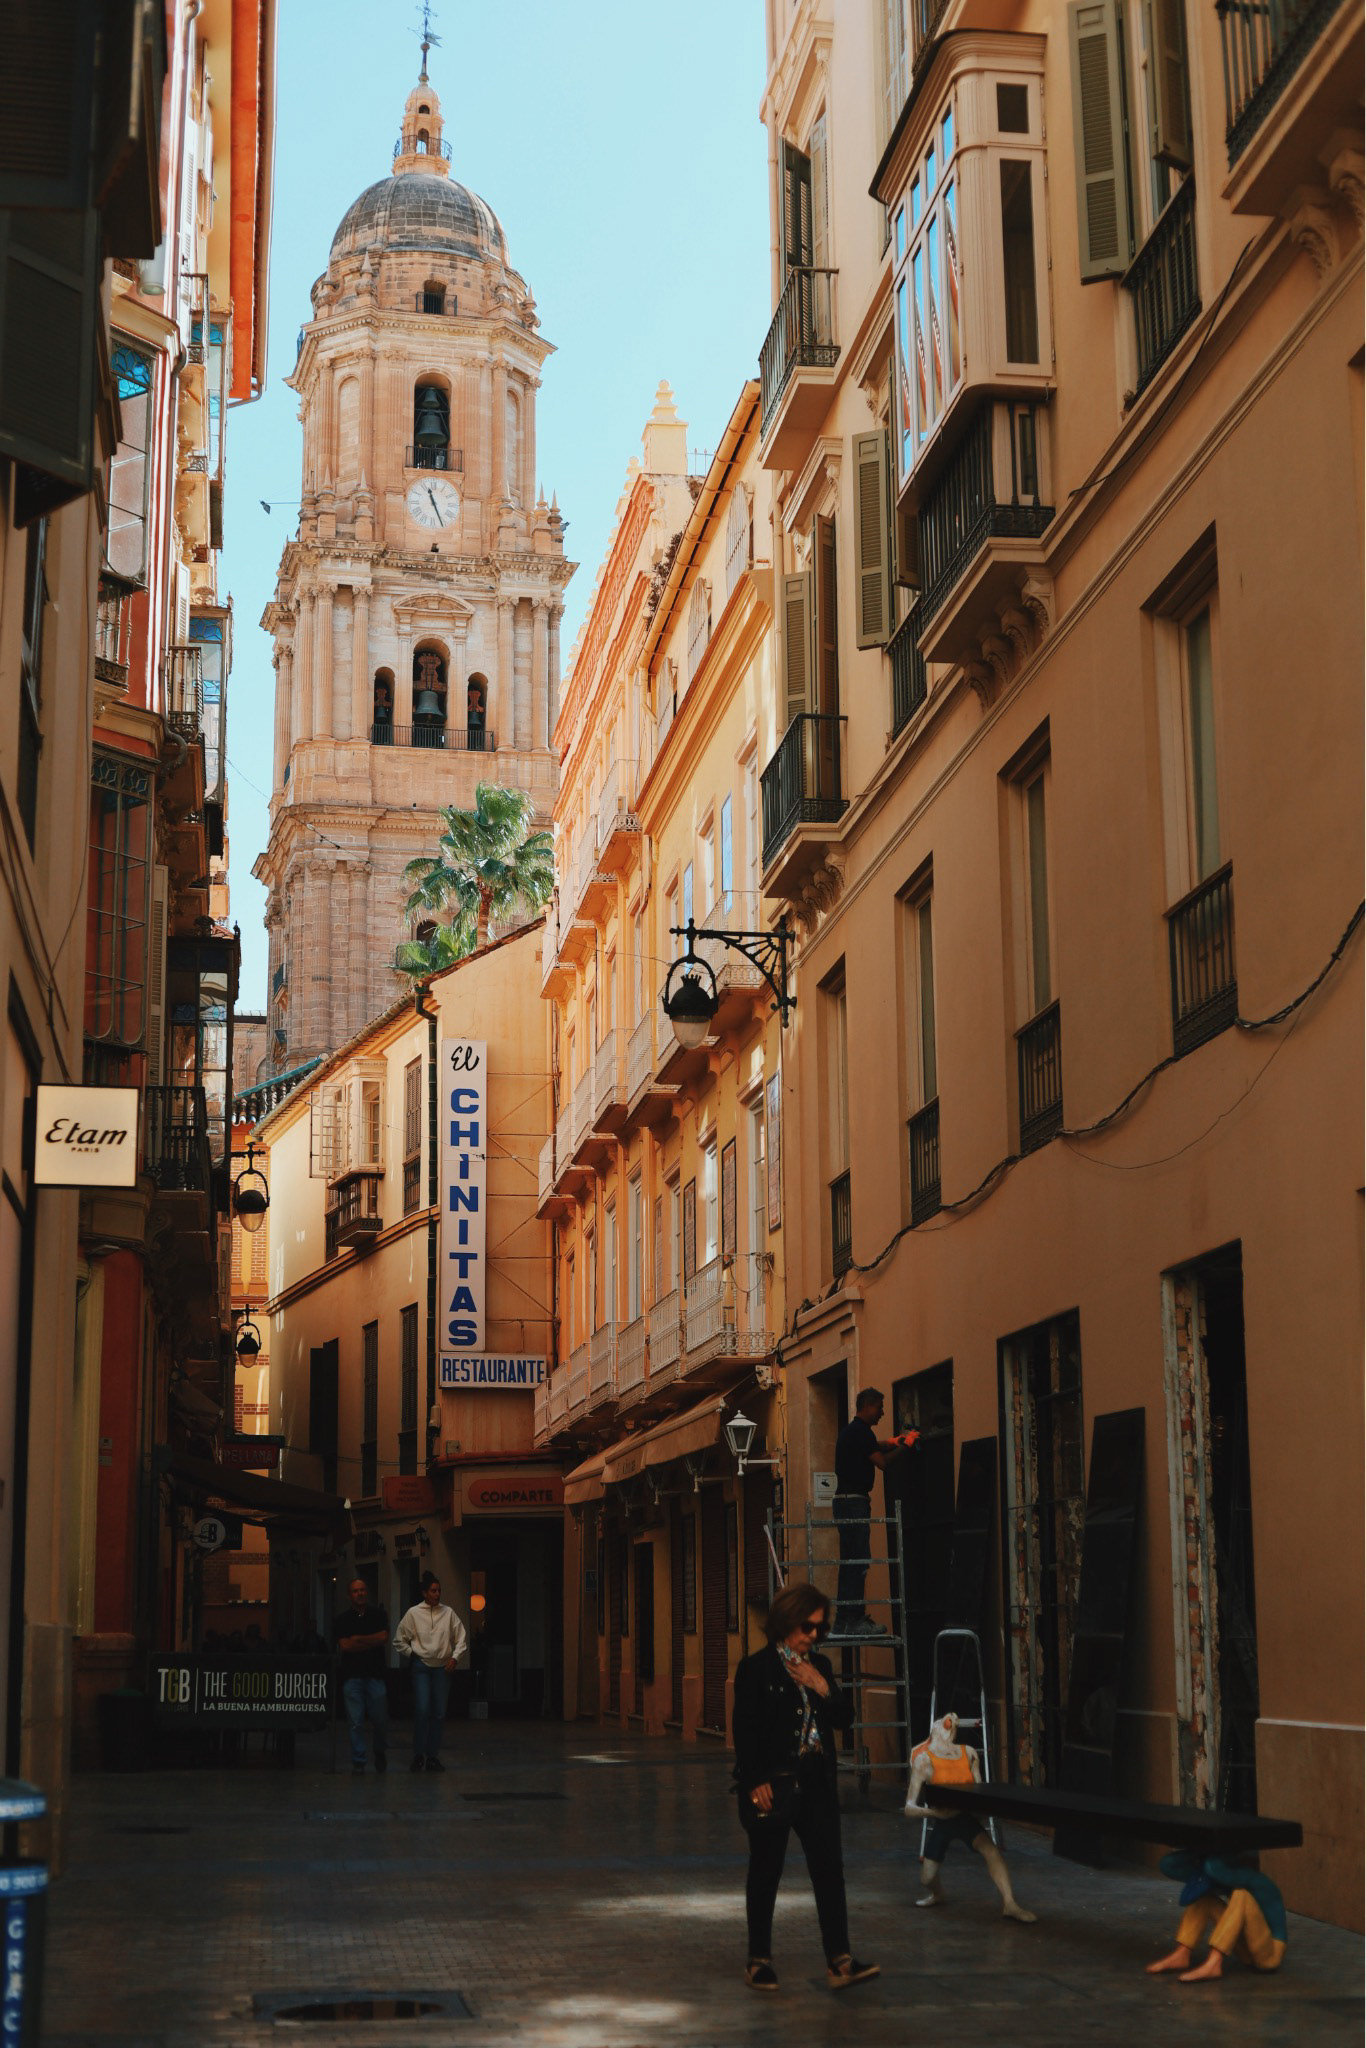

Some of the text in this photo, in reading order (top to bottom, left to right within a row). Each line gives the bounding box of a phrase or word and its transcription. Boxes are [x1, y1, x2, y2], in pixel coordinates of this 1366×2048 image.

[451, 1045, 480, 1072] El
[45, 1118, 128, 1145] Etam
[448, 1087, 480, 1347] CHINITAS
[441, 1358, 545, 1384] RESTAURANTE
[480, 1489, 553, 1504] COMPARTE
[157, 1668, 191, 1704] TGB
[203, 1671, 327, 1699] THE GOOD BURGER
[202, 1702, 326, 1712] LA BUENA HAMBURGUESA
